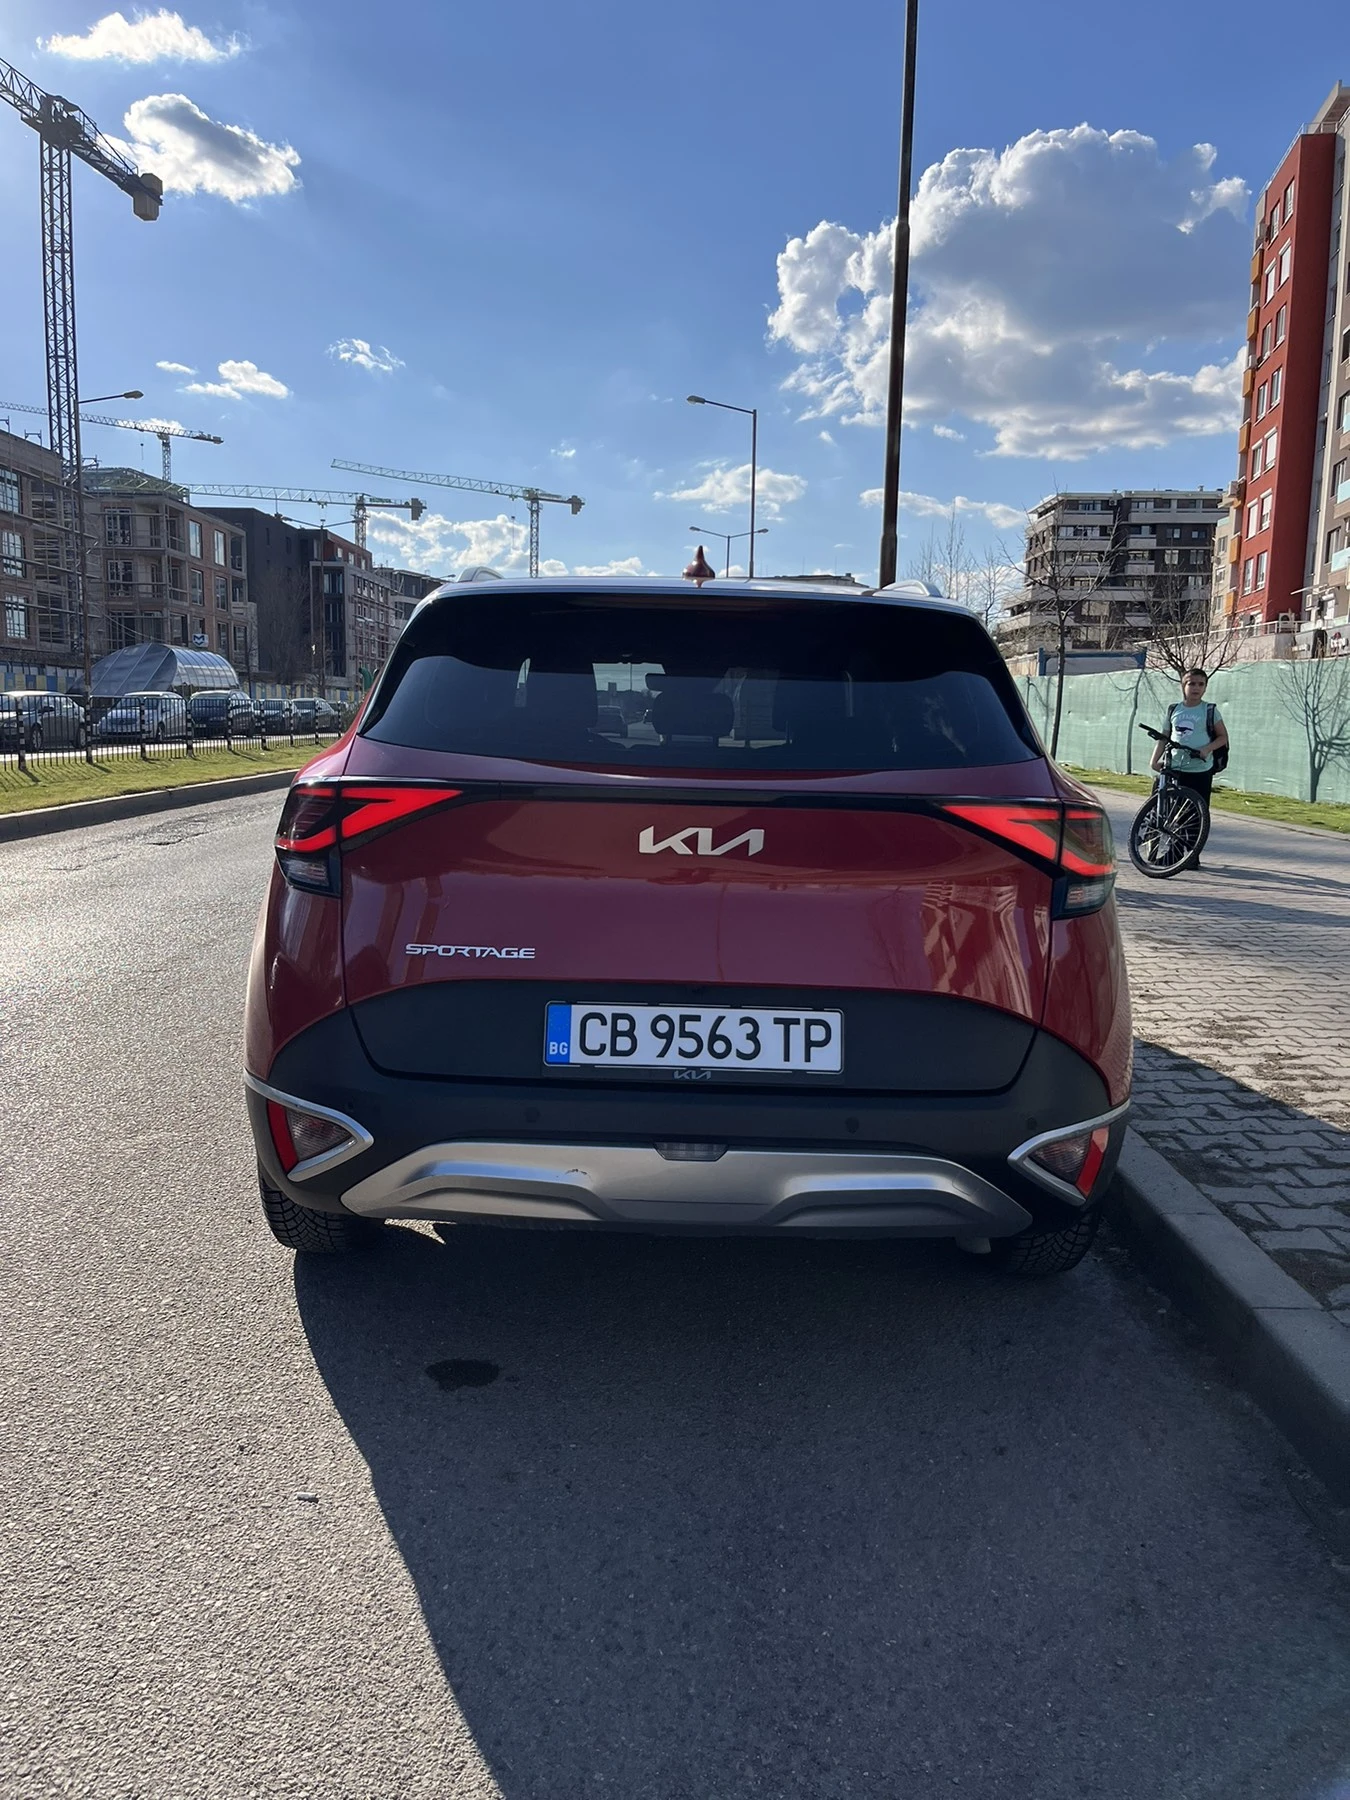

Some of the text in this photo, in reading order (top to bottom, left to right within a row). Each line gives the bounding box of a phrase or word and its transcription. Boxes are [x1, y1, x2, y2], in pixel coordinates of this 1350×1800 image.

[638, 825, 765, 857] KIA
[405, 943, 536, 959] SPORTAGE
[579, 1012, 832, 1063] CB 9563 TP
[549, 1042, 568, 1055] BG
[673, 1069, 712, 1081] KIA
